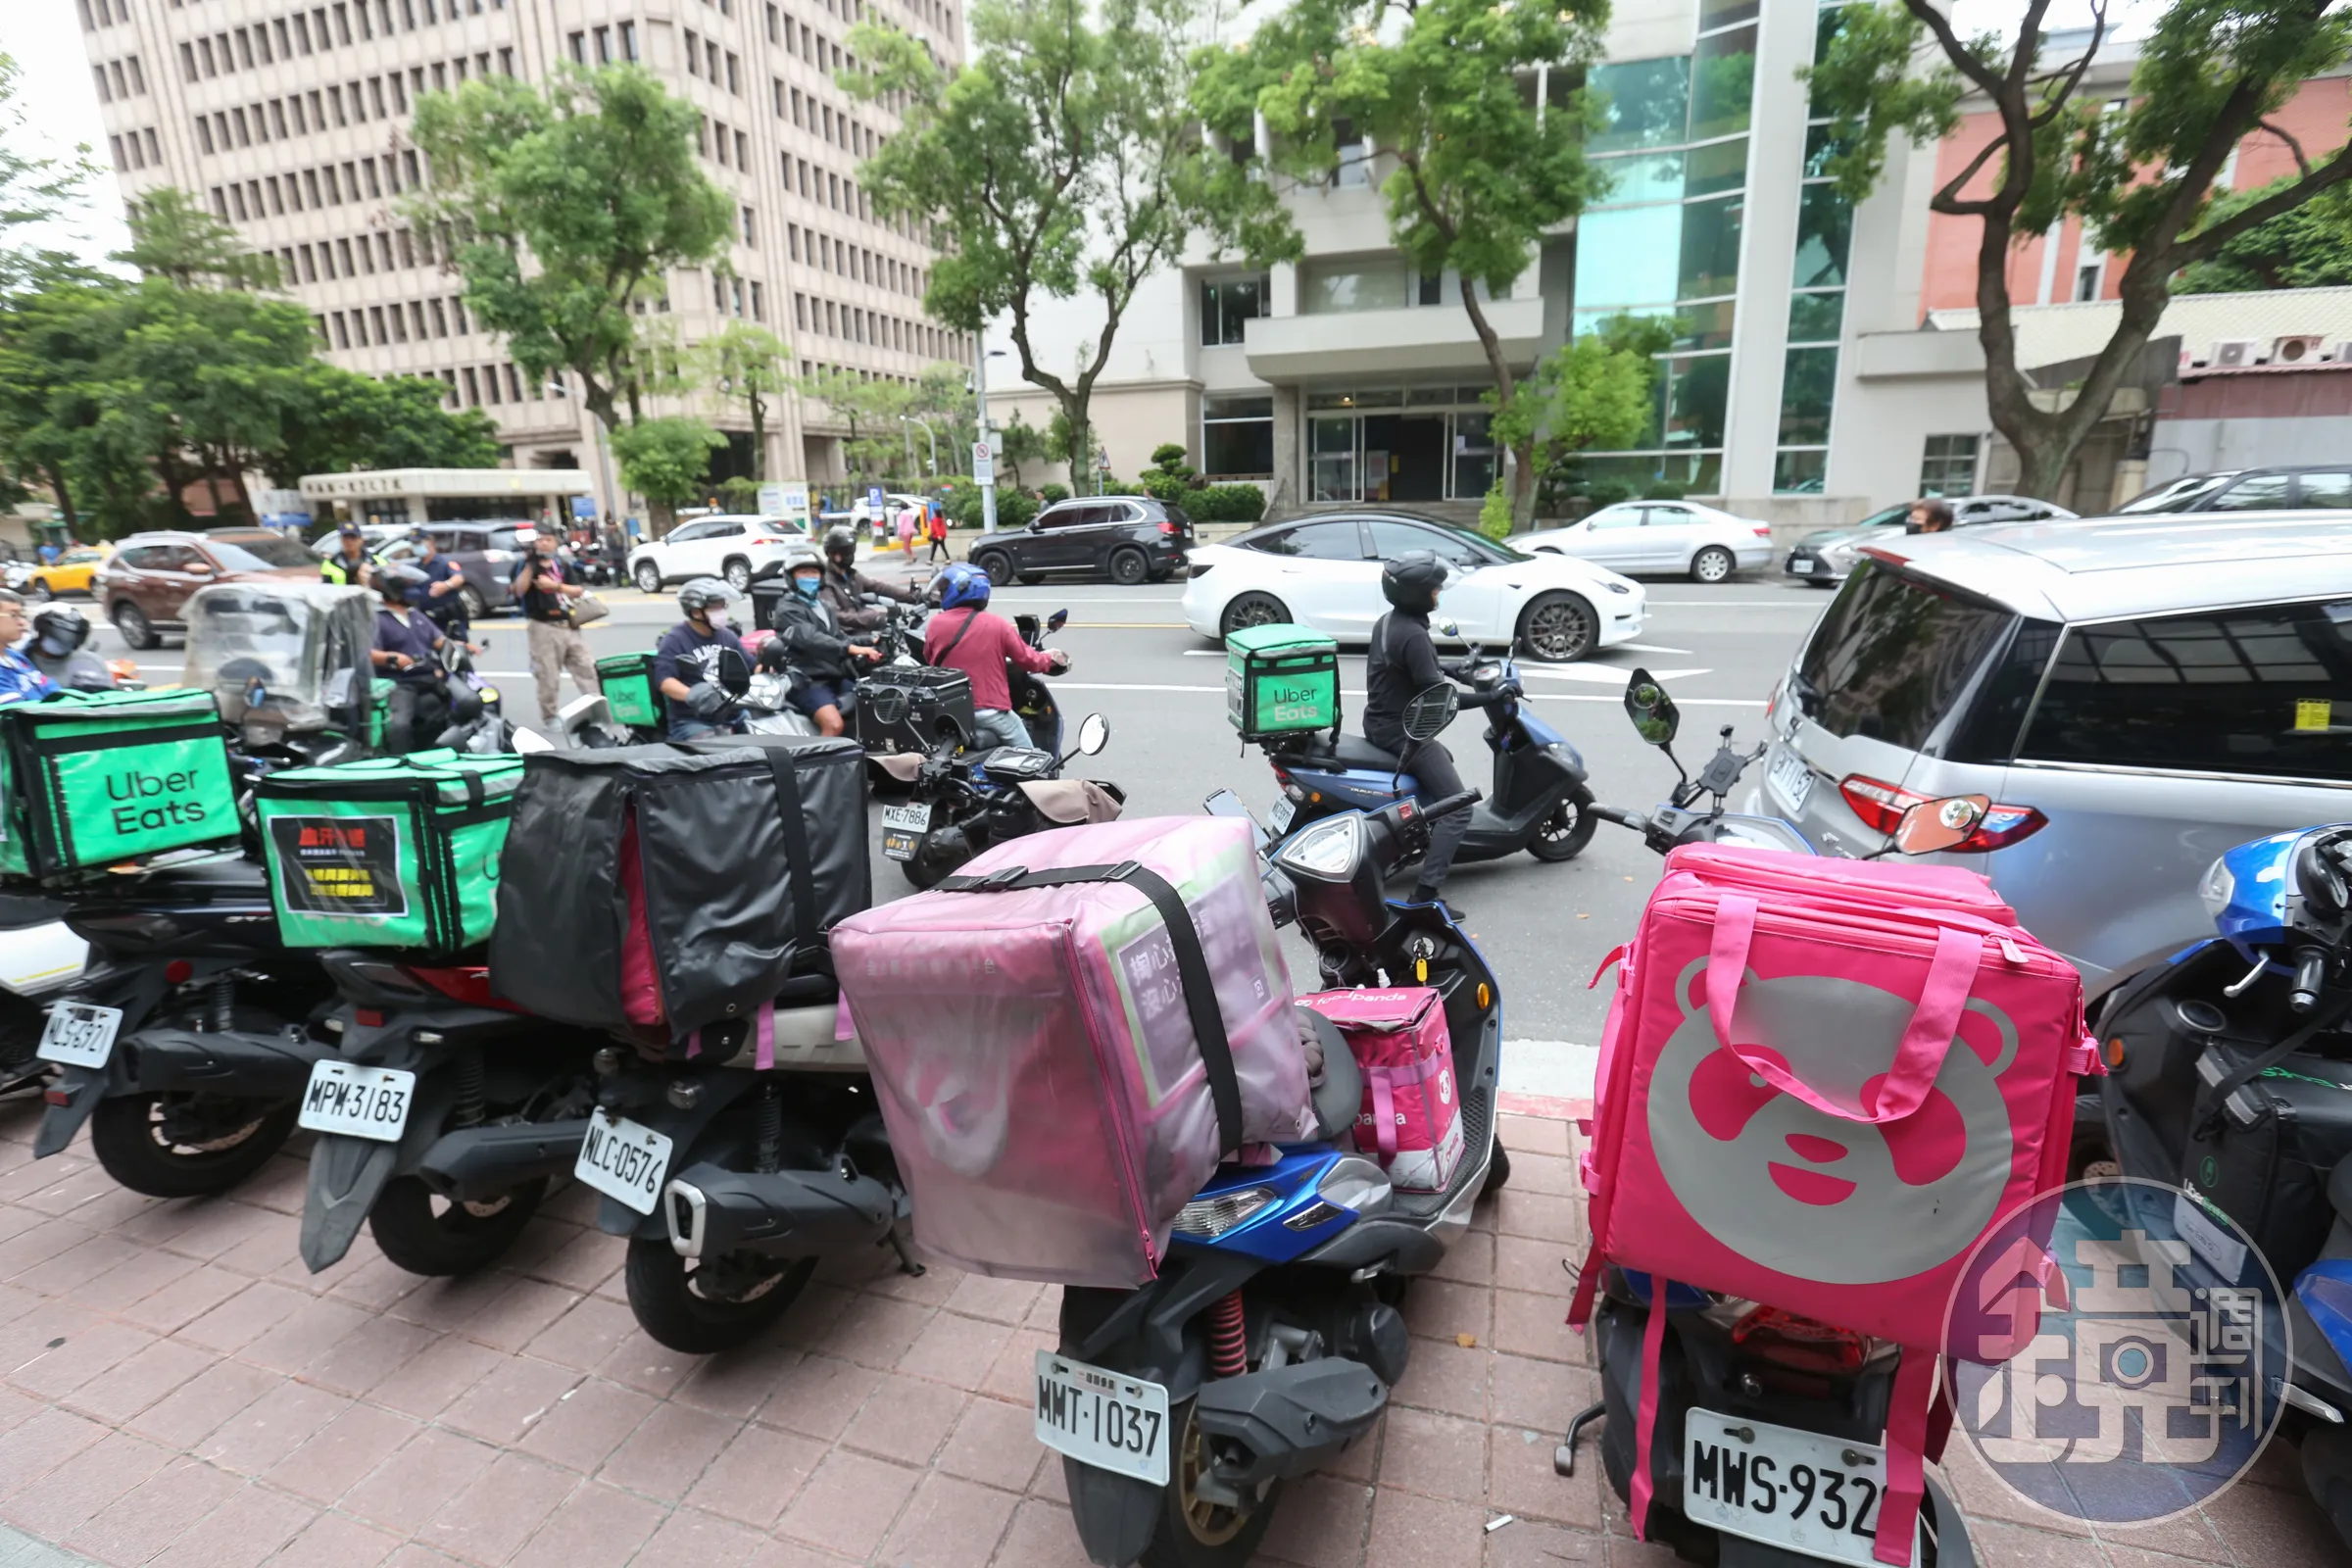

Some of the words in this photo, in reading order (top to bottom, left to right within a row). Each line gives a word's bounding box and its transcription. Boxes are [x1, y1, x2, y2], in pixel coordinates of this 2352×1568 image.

[1274, 688, 1317, 704] Uber
[1274, 705, 1317, 721] Eats
[106, 769, 198, 802] Uber
[112, 801, 206, 836] Eats
[1316, 991, 1407, 1005] foodpanda
[1352, 1112, 1406, 1131] paa
[583, 1125, 662, 1194] NLC-0576
[1039, 1375, 1161, 1457] MMT-1037
[1693, 1440, 1887, 1540] MWS-932
